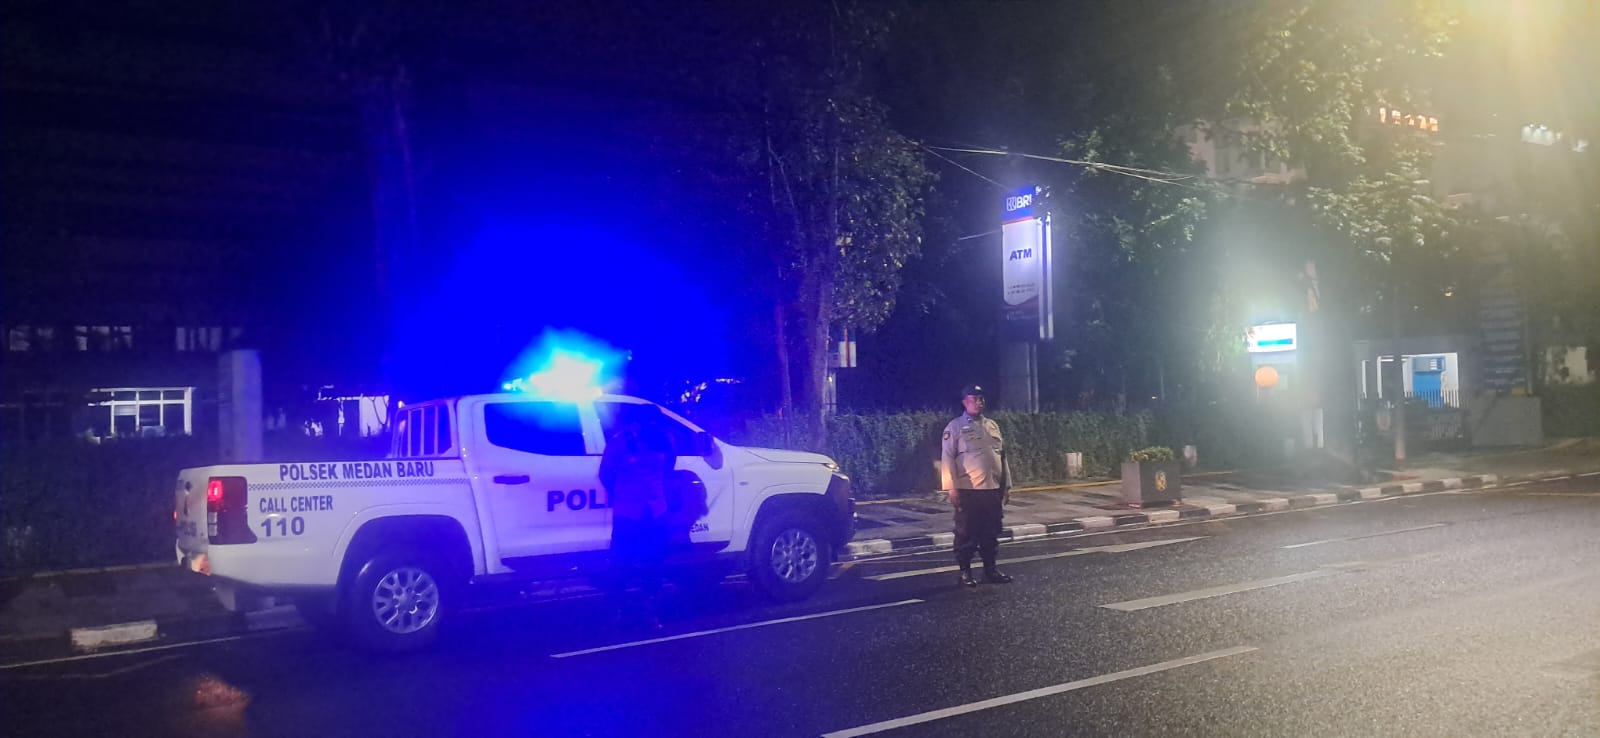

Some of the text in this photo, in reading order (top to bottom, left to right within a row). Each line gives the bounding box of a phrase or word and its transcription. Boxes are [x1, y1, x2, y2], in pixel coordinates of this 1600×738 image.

[1009, 248, 1032, 261] ATM
[279, 461, 435, 481] POLSEK MEDAN BARU
[259, 495, 334, 513] CALL CENTER
[547, 489, 612, 512] POL
[260, 516, 306, 537] 110
